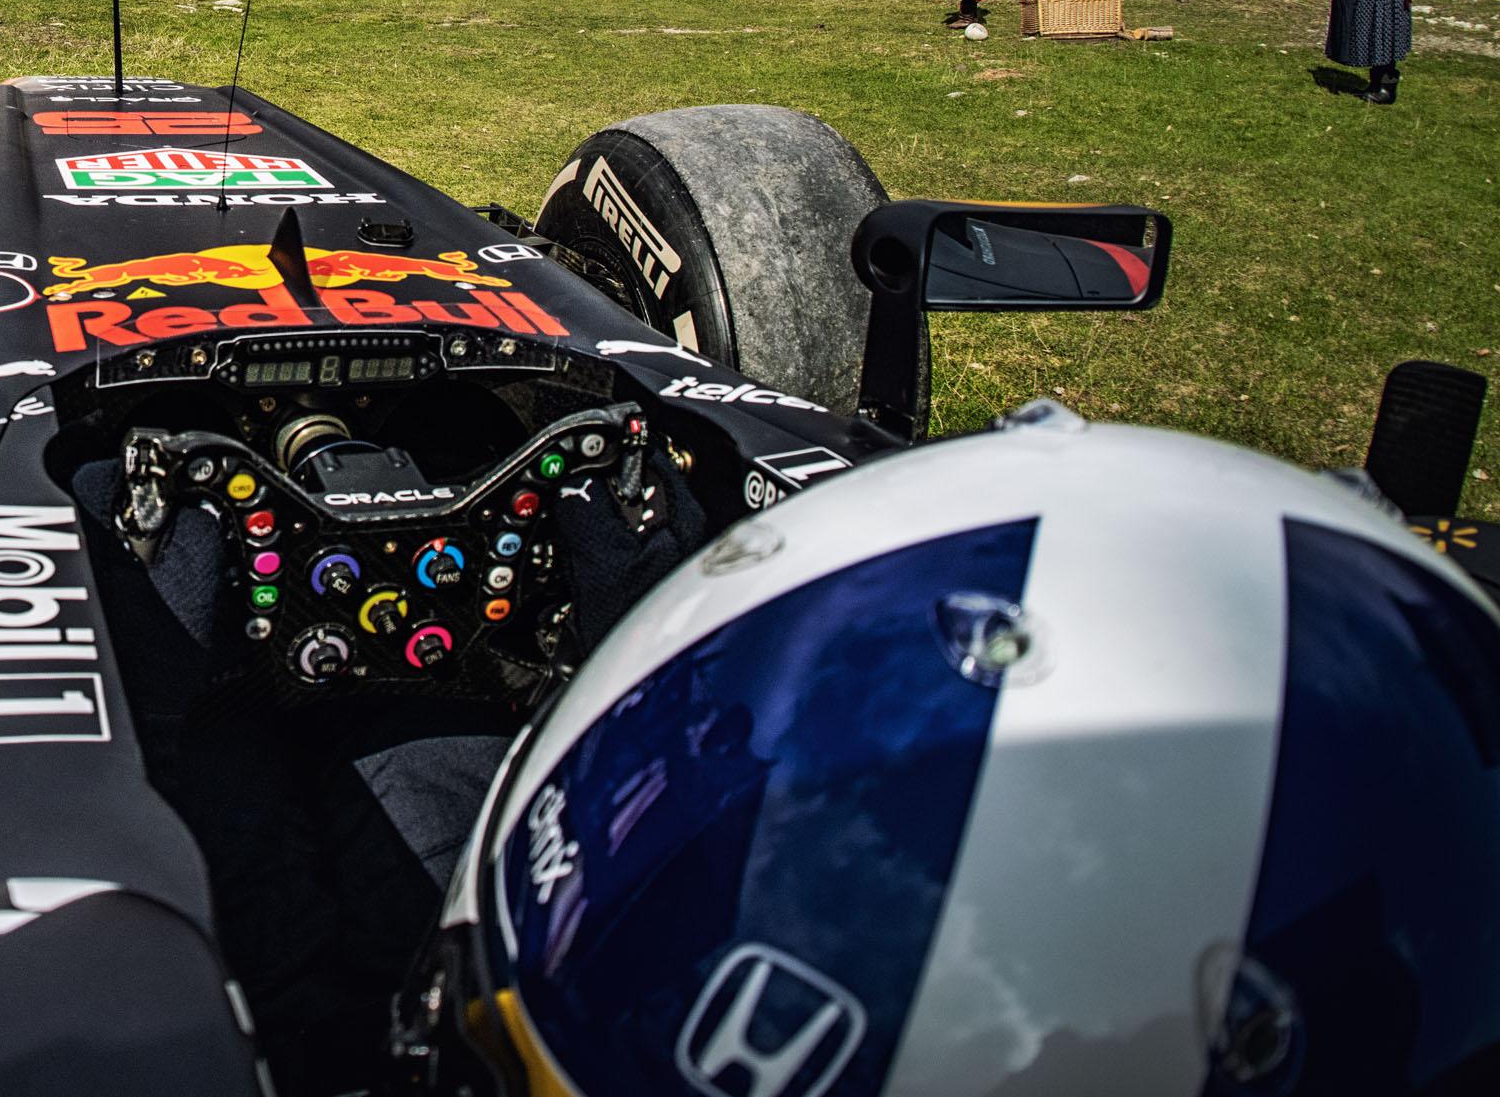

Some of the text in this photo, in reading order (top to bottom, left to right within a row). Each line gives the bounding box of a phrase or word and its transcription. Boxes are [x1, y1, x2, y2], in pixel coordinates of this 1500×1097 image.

[75, 149, 294, 170] HEUER
[86, 170, 309, 187] TAG
[42, 193, 387, 206] HONDA
[583, 155, 682, 300] PIRELLI
[46, 288, 571, 353] Red Bull
[548, 461, 561, 475] N
[323, 485, 455, 507] ORACLE
[436, 572, 461, 585] FANS
[495, 573, 508, 584] OK
[256, 592, 276, 603] OIL
